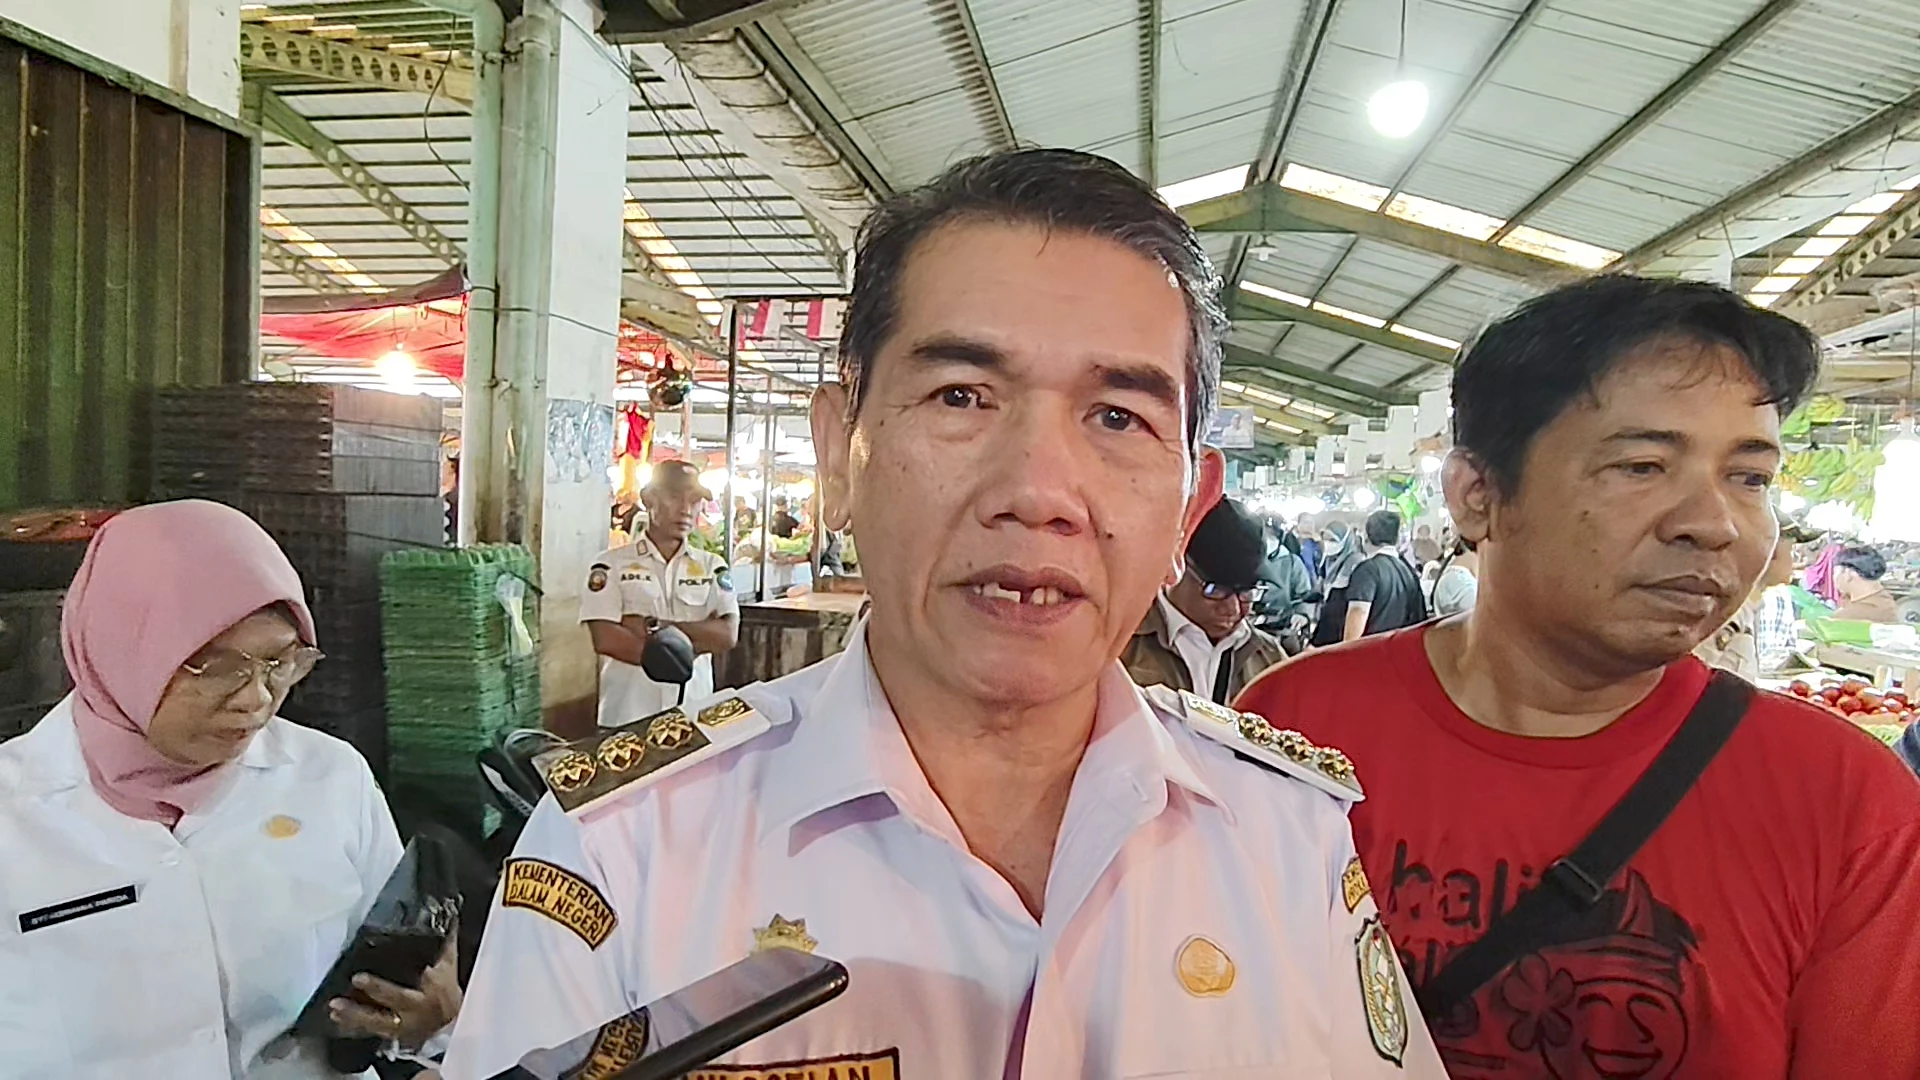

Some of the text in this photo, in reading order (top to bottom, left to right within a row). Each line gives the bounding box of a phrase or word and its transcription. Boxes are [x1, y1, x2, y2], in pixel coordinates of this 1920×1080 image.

[508, 882, 550, 907] DALAM
[513, 863, 610, 928] KEMENTERIAN
[551, 896, 604, 942] NEGERI
